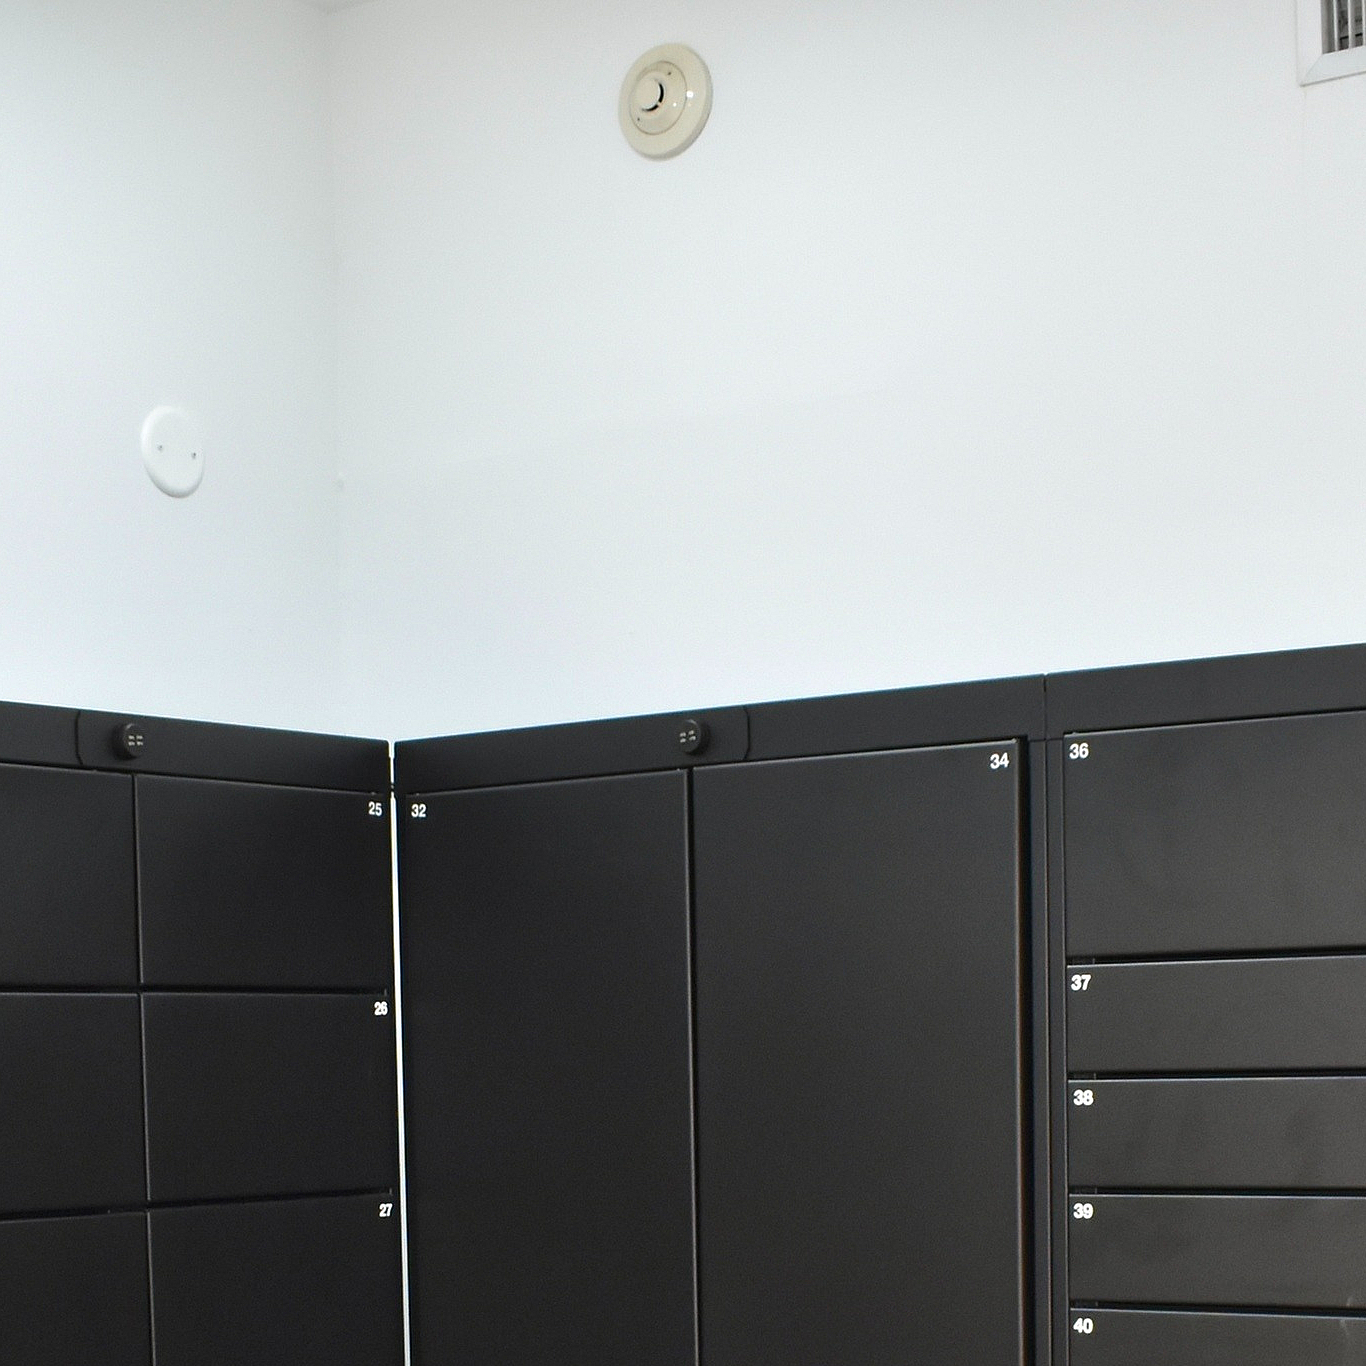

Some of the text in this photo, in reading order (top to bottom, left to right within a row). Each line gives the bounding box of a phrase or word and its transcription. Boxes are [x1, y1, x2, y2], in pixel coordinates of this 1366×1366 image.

[1068, 742, 1090, 760] 36
[989, 751, 1010, 770] 34
[368, 801, 383, 817] 25
[410, 803, 427, 818] 32
[1070, 973, 1092, 992] 37
[373, 1000, 389, 1016] 26
[1072, 1089, 1094, 1106] 38
[378, 1202, 393, 1218] 27
[1072, 1202, 1094, 1220] 39
[1072, 1317, 1094, 1335] 40
